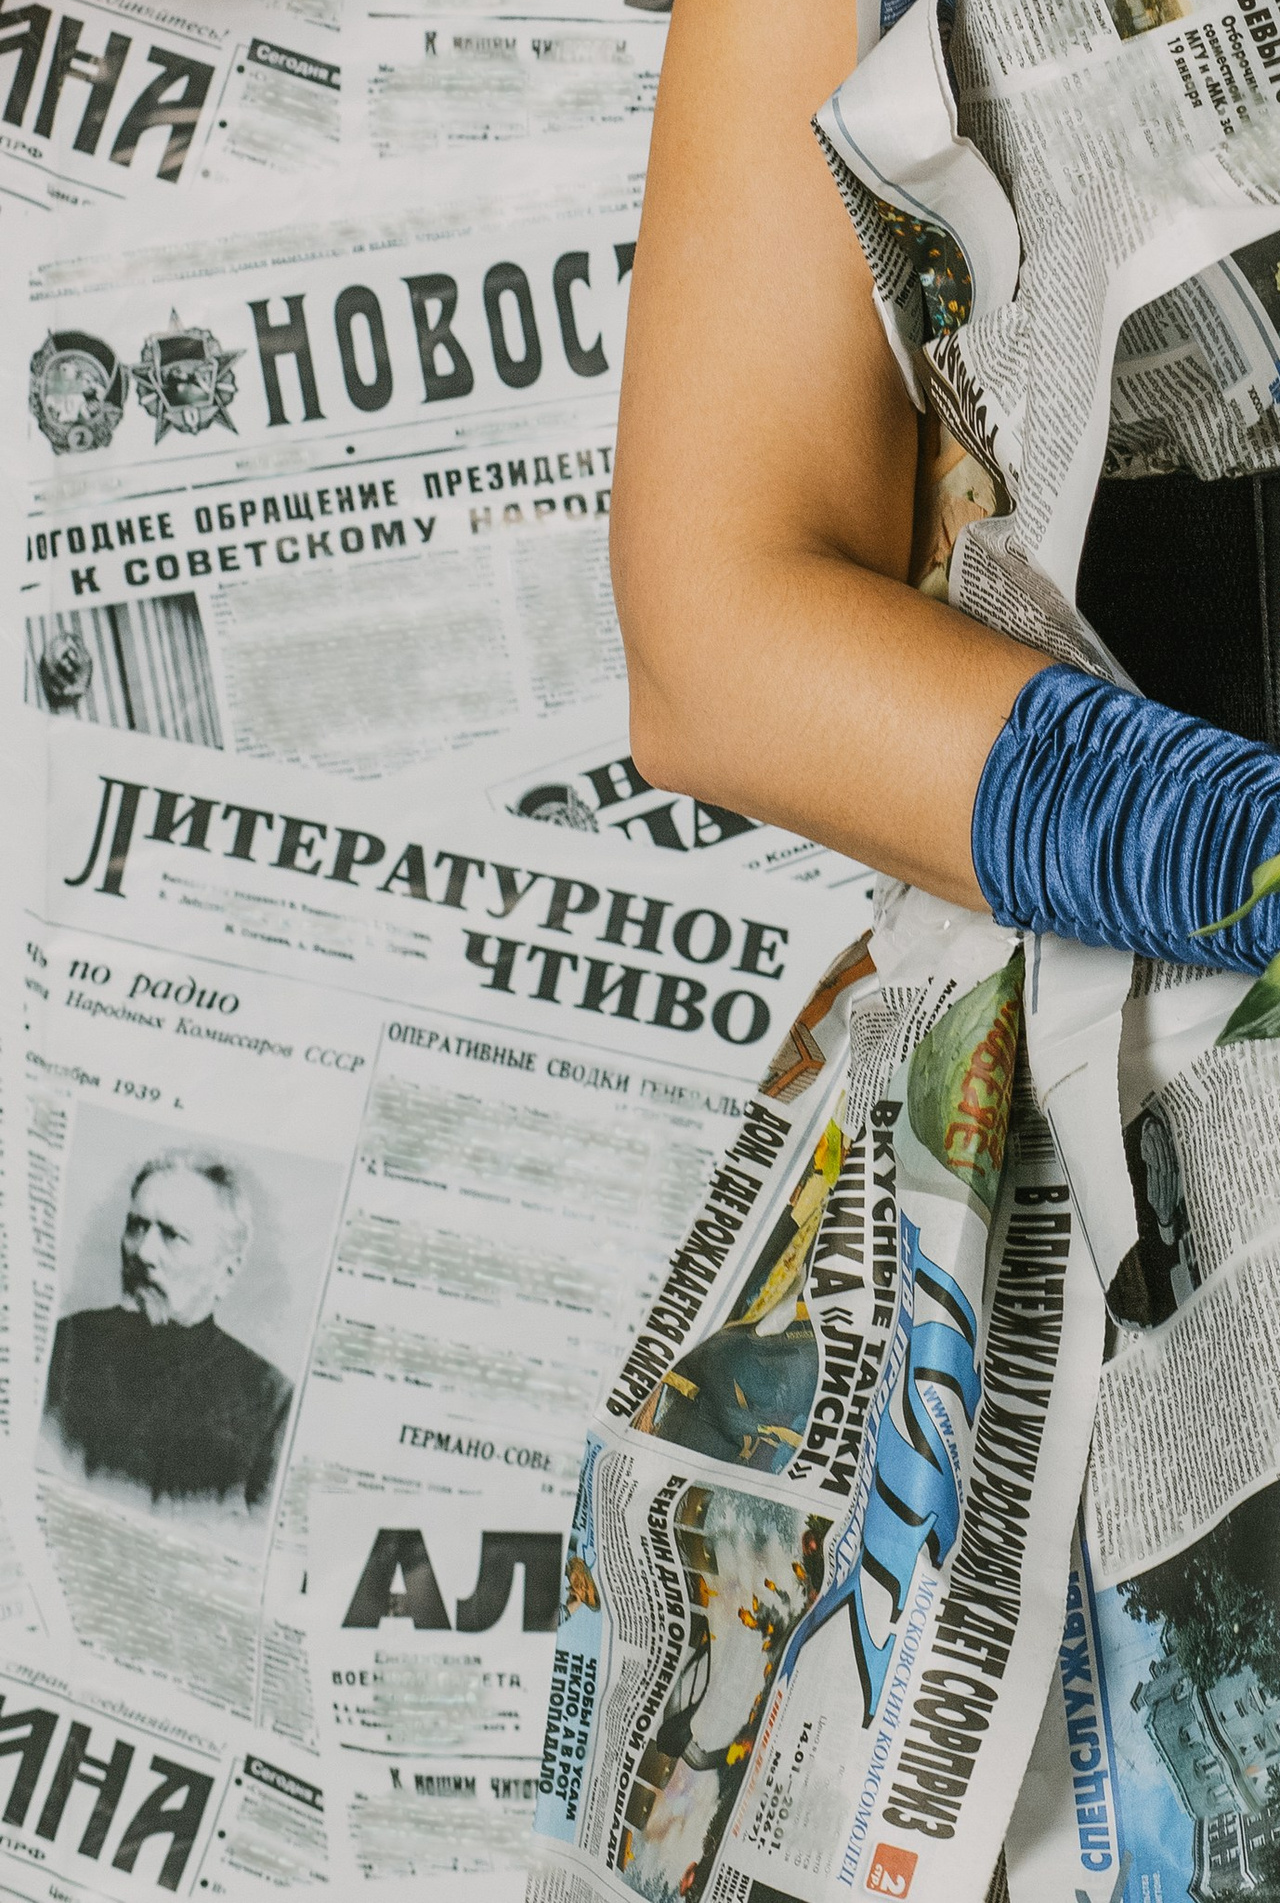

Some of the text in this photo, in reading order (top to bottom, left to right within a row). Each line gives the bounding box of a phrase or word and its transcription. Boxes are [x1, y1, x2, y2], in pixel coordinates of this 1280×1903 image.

[255, 44, 330, 81] Сегодня
[1165, 35, 1204, 110] 19 января
[1182, 27, 1209, 63] МГУ
[196, 479, 398, 536] ОБРАЩЕНИЕ
[423, 445, 613, 501] ПРЕЗИДЕНТ
[70, 488, 612, 596] К СОВЕТСКОМУ НАРОД
[63, 774, 790, 982] ЛИТЕРАТУРНОЕ
[65, 987, 366, 1076] Народных Комиссаров СССР
[67, 952, 241, 1016] по радио
[462, 928, 773, 1049] ЧТИВО
[111, 1077, 162, 1104] 1939
[387, 1021, 631, 1095] ОПЕРАТИВНЫЕ СВОДКИ
[709, 1163, 763, 1206] ГДЕ
[724, 1101, 792, 1170] ДОМ,
[868, 1102, 902, 1329] ВКУСНЫЕ
[645, 1196, 750, 1351] РОЖДАЕТСЯ
[606, 1335, 679, 1421] СМЕРТЬ
[786, 1305, 860, 1483] «ЛИСЫ»
[819, 1336, 885, 1498] ТАНКИ
[882, 1185, 1072, 1840] В ПЛАТЕЖКАХ РОССИЯН ЖДЕТ СЮРПРИЗ
[537, 1649, 569, 1793] НЕ ПОПАДАЛО
[604, 1474, 687, 1870] БЕНЗИН ДЛЯ ОГНЕННОЙ ЛОШАДИ
[555, 1652, 585, 1799] ТЕКЛО, А В РОТ
[564, 1657, 597, 1820] ЧТОБЫ ПО УСАМ
[836, 1573, 938, 1887] МОСКОВСКИЙ КОМСОМОЛЕЦ
[865, 1863, 883, 1890] стр.
[877, 1868, 909, 1898] 2
